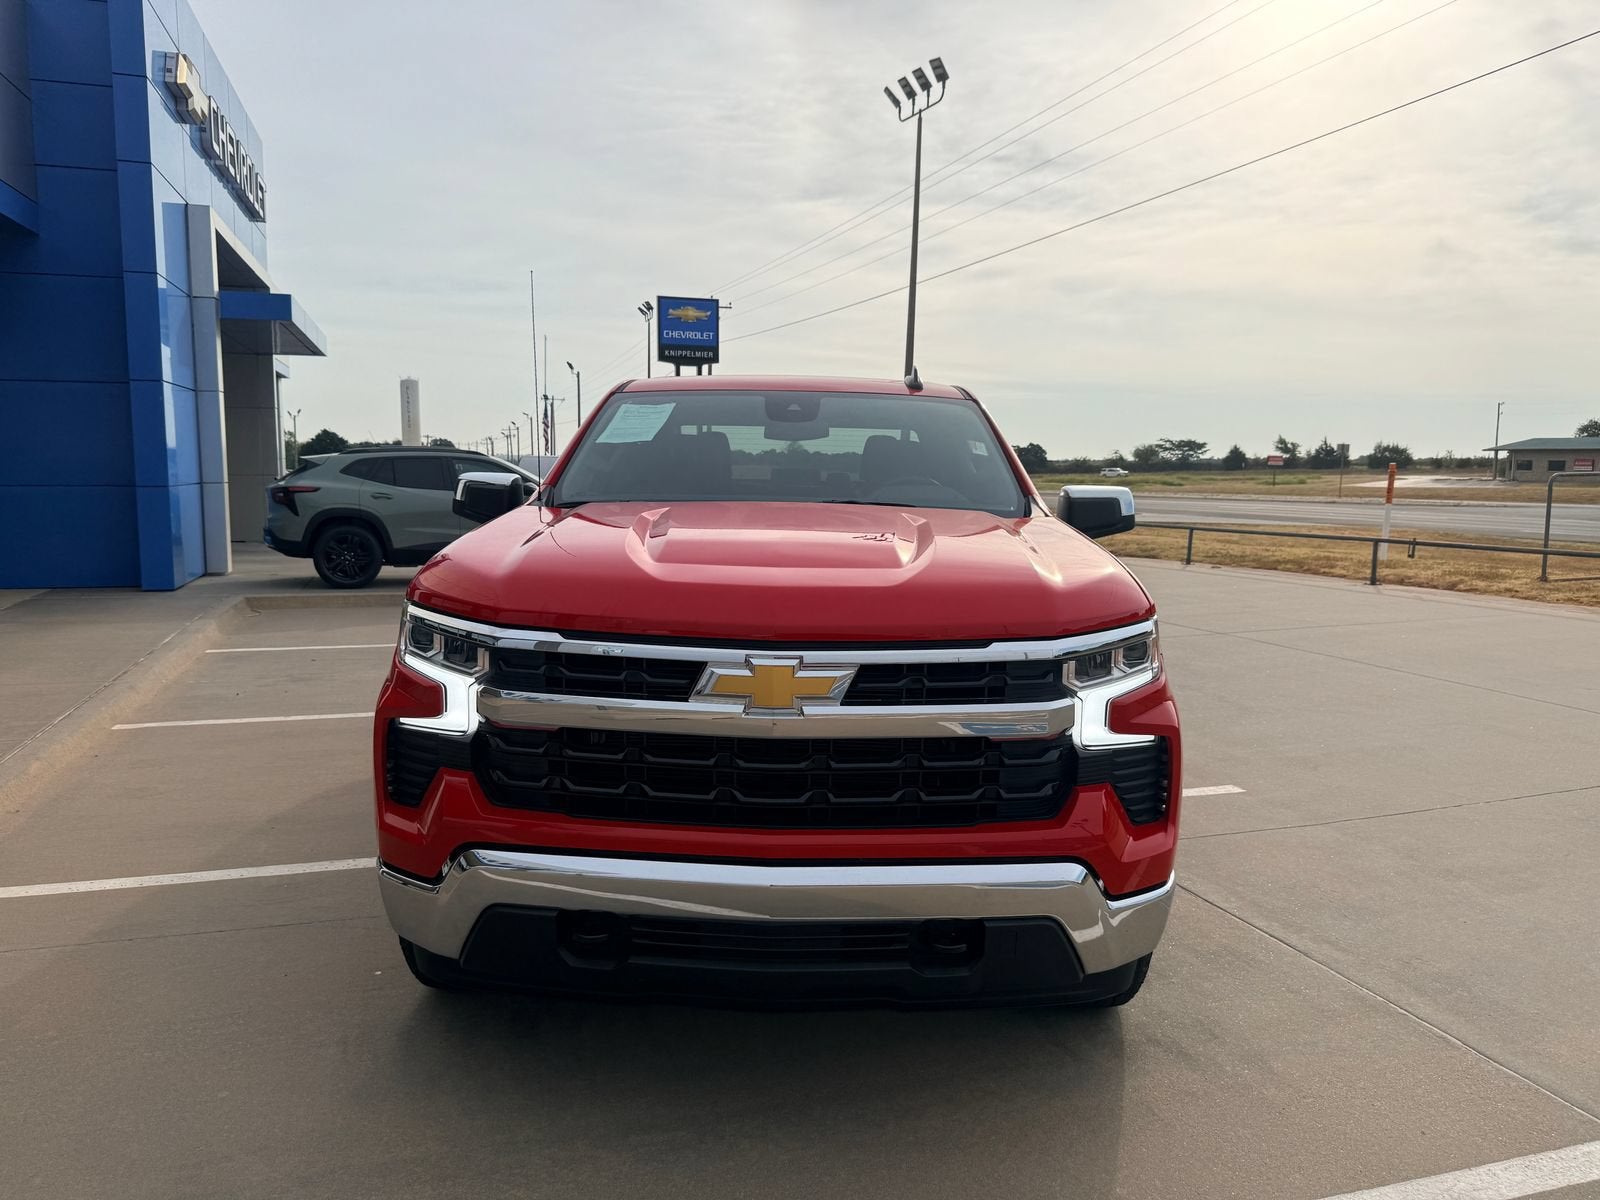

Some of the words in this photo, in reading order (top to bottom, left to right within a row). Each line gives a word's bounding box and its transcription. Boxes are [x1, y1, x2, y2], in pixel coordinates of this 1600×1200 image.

[207, 95, 267, 221] CHEVROLET
[663, 330, 714, 340] CHEVROLET
[664, 350, 714, 358] KNIPPELMIER
